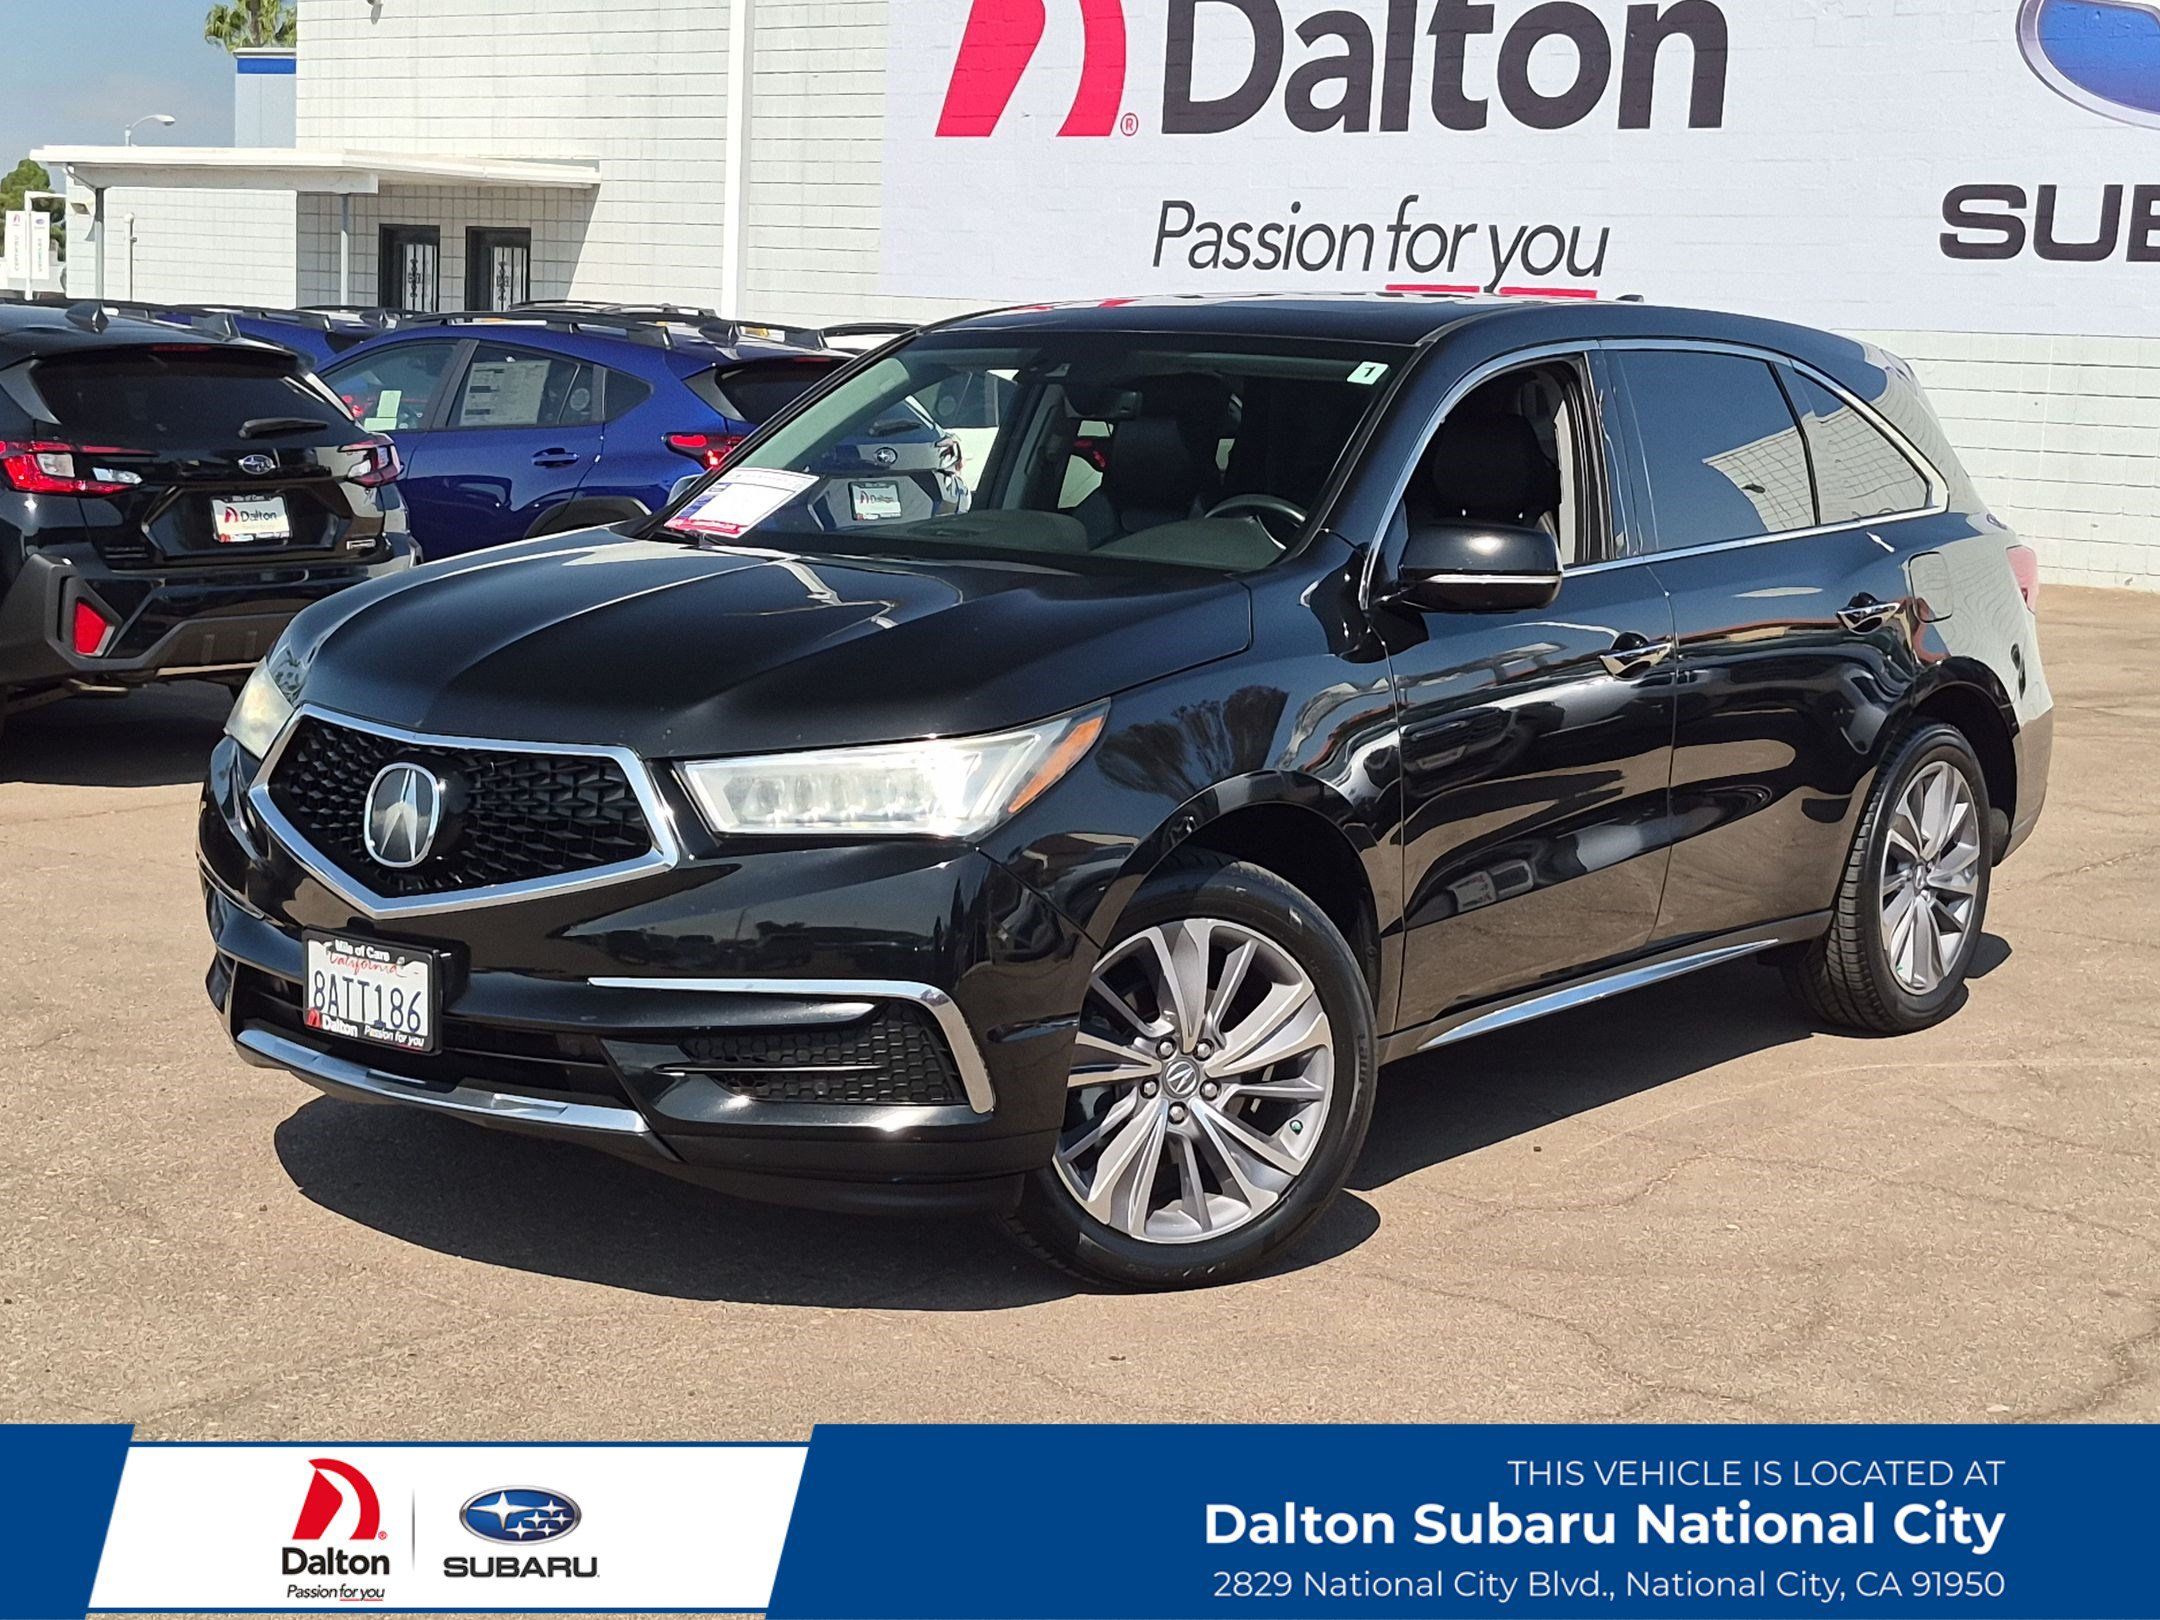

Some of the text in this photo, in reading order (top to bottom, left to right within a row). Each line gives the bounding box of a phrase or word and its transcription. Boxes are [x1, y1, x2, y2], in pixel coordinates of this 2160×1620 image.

[1162, 0, 1728, 135] Dalton
[1153, 194, 1610, 293] Passion for you
[240, 509, 277, 522] Dalton
[335, 939, 391, 962] Mile of Cars
[314, 969, 421, 1033] 8ATT186
[322, 1014, 425, 1048] Dalton Passion for you
